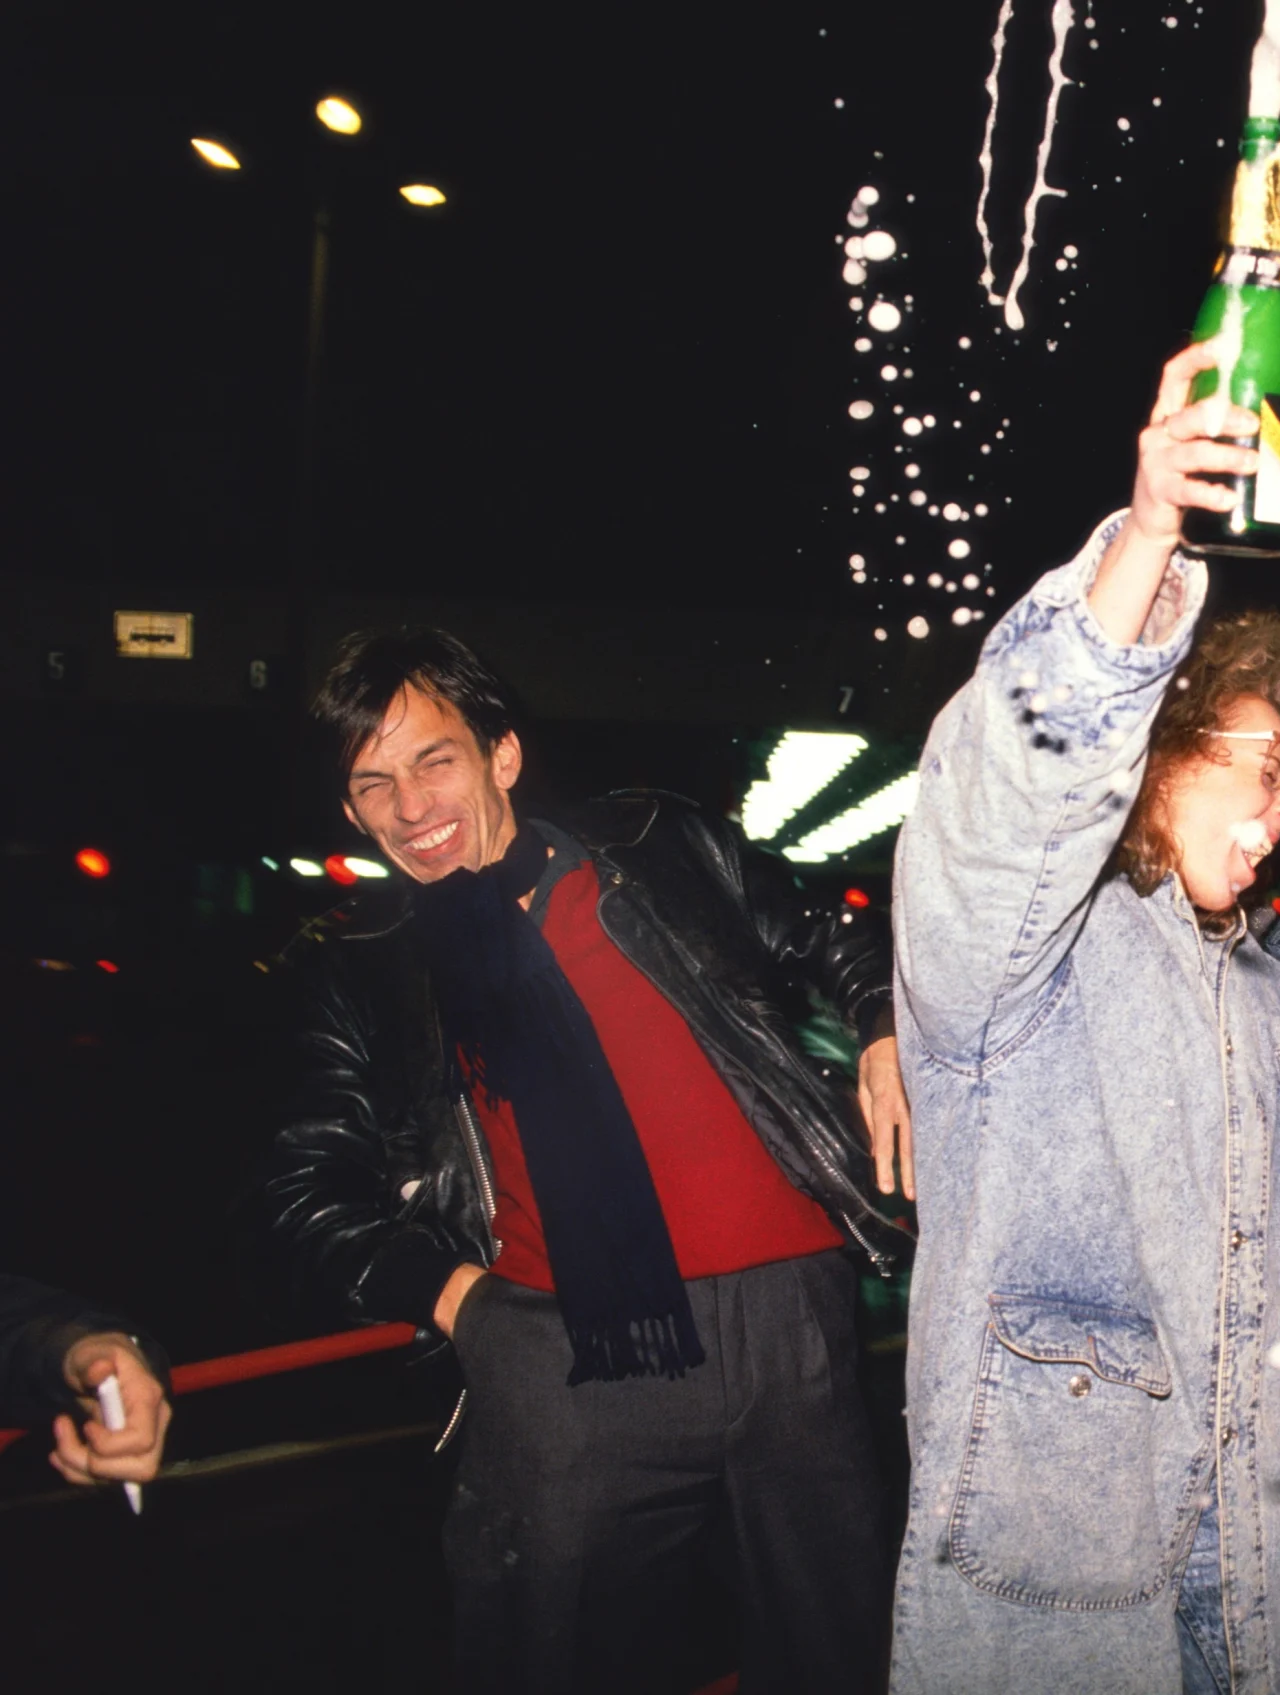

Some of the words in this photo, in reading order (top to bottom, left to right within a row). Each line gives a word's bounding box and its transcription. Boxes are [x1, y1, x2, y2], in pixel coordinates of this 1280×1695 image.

[48, 652, 65, 680] 5
[250, 660, 267, 689] 6
[838, 686, 855, 714] 7
